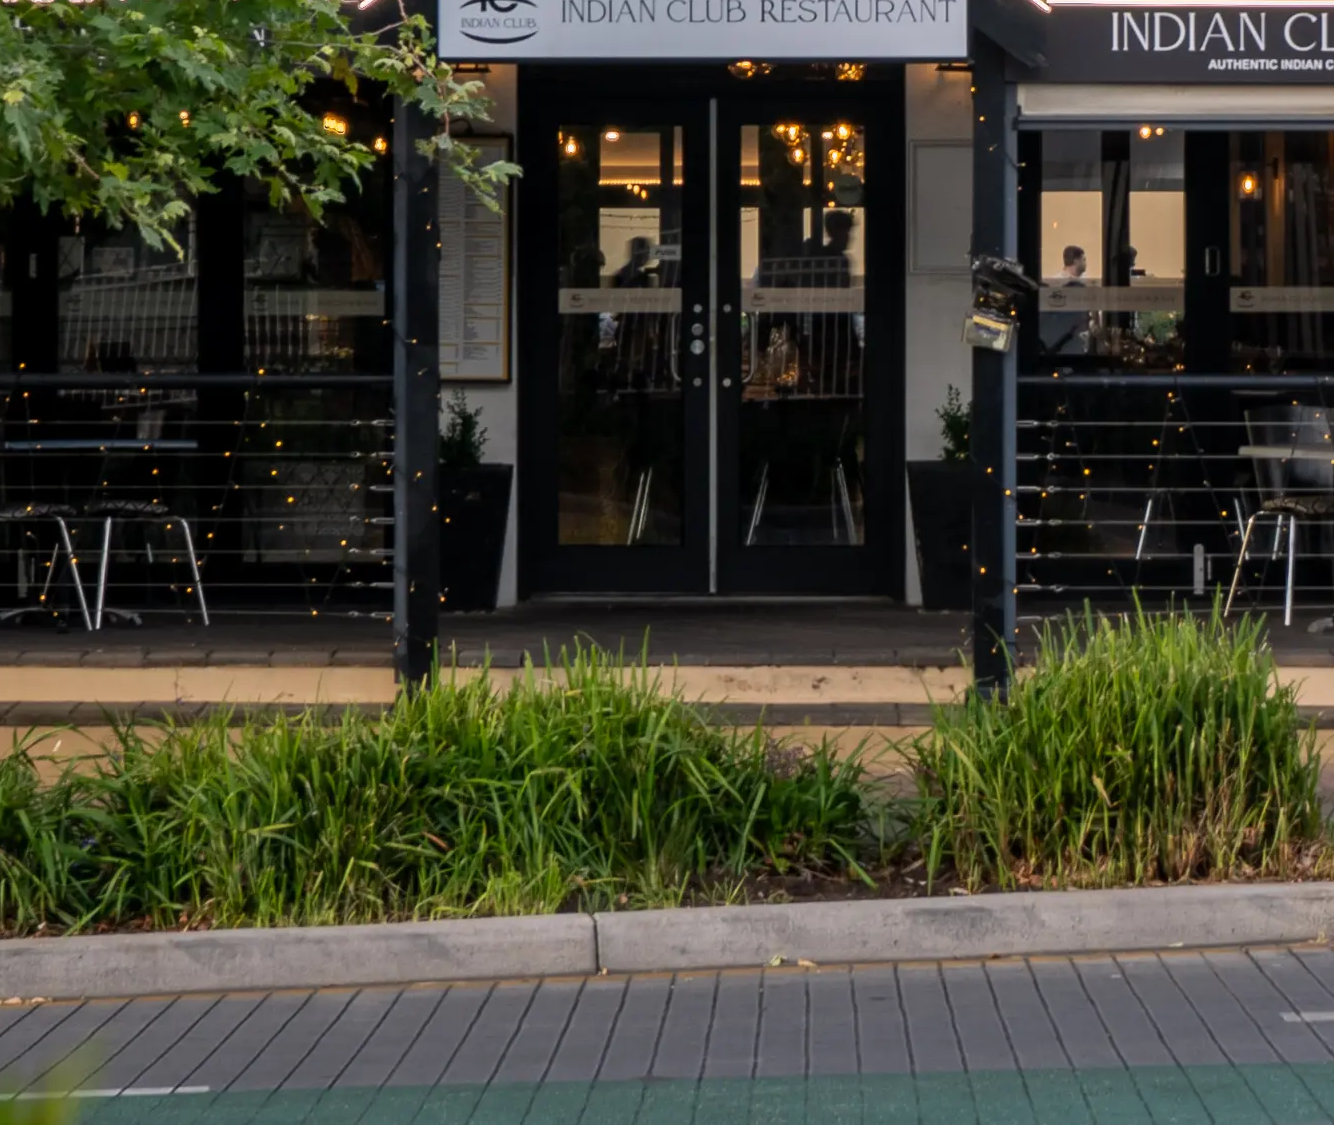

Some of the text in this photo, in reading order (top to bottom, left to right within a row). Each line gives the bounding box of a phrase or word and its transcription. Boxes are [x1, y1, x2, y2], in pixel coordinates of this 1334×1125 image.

[561, 0, 957, 24] INDIAN CLUB RESTAURANT
[460, 17, 537, 29] INDIAN CLUB
[1110, 12, 1266, 52] INDIAN
[1208, 59, 1278, 71] AUTHENTIC
[1280, 59, 1323, 71] INDIAN
